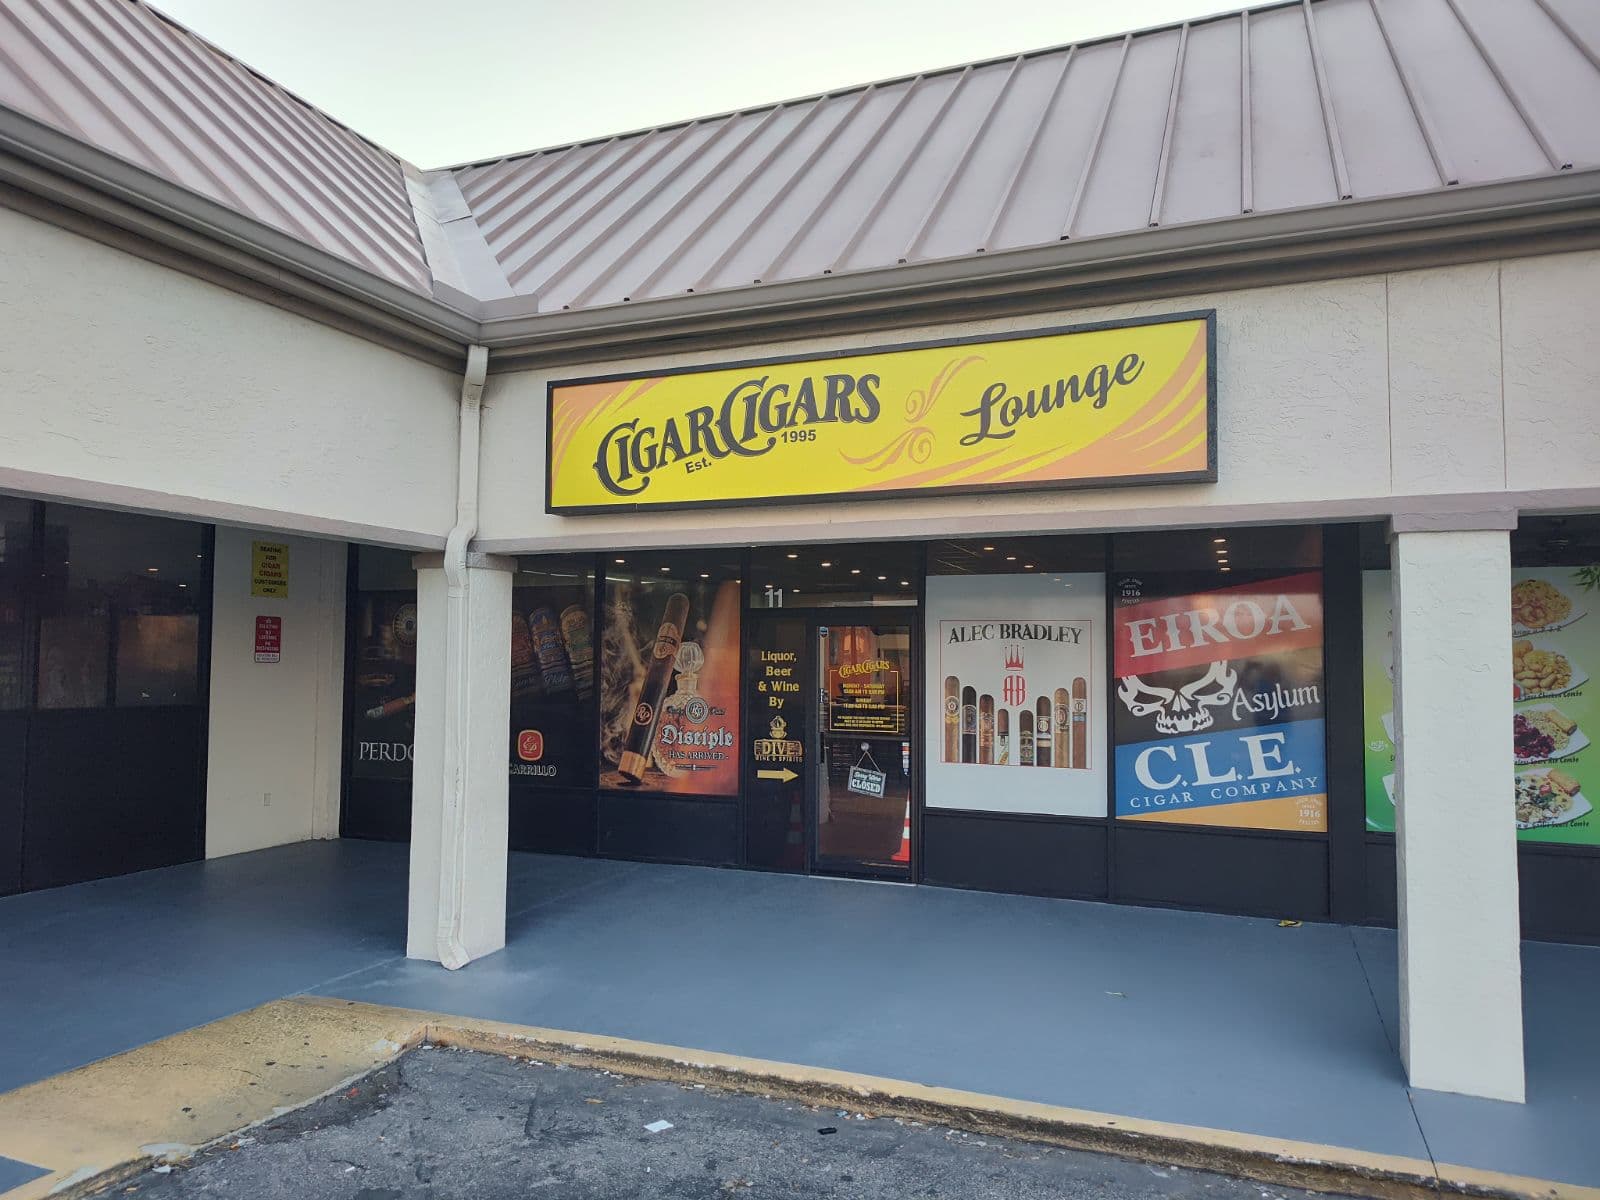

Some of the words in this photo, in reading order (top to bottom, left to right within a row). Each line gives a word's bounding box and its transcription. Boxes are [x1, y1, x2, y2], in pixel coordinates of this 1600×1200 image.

[960, 353, 1145, 446] Lounge
[685, 457, 712, 474] Est.
[781, 429, 817, 444] 1995
[765, 588, 783, 608] 11
[1121, 589, 1141, 597] 1916
[948, 623, 994, 645] ALEC
[998, 623, 1083, 645] BRADLEY
[1125, 595, 1313, 658] EIROA
[761, 650, 797, 663] Liquor,
[766, 666, 792, 677] Beer
[758, 681, 767, 692] &
[771, 681, 800, 692] Wine
[769, 697, 784, 709] By
[1232, 683, 1321, 721] Asylum
[661, 725, 733, 750] Disciple
[668, 751, 686, 759] HAS
[762, 742, 796, 755] DIVE
[1135, 731, 1301, 790] C.L.E.
[852, 779, 880, 793] CLOSED
[1130, 792, 1194, 808] CIGAR
[1211, 776, 1319, 799] COMPANY
[1300, 809, 1321, 818] 1916
